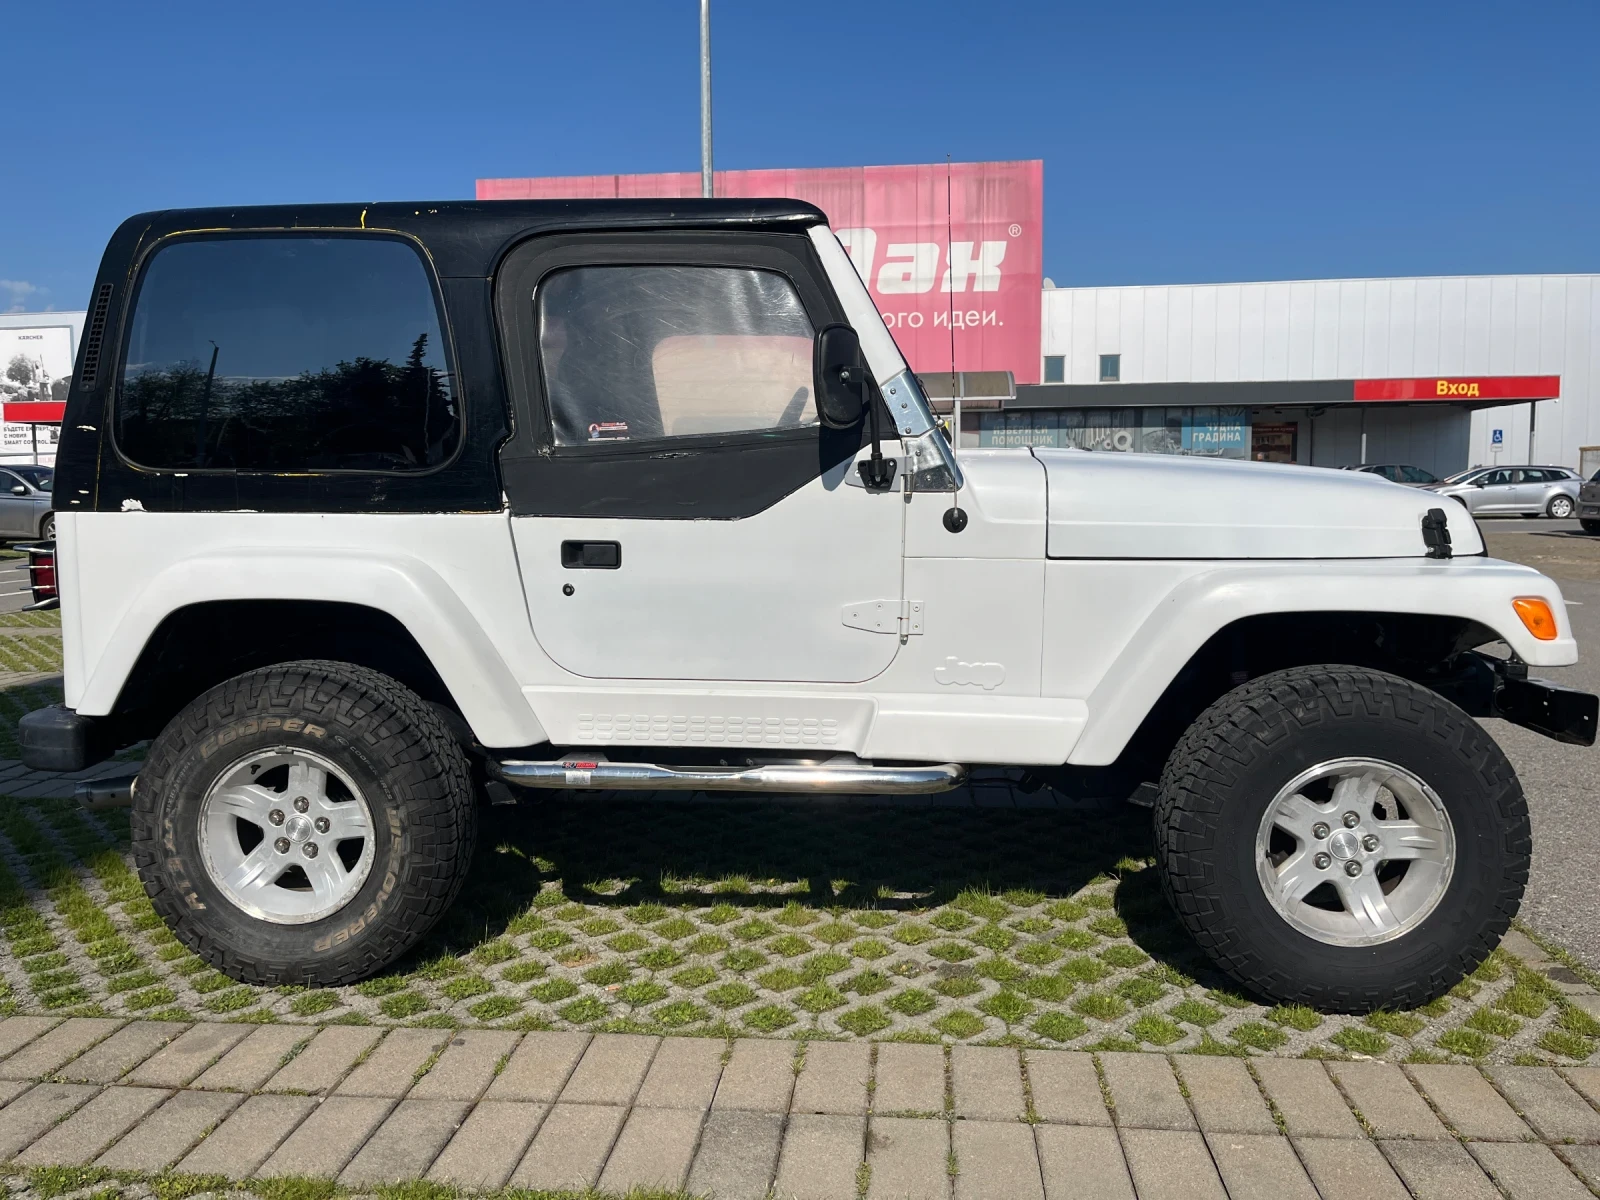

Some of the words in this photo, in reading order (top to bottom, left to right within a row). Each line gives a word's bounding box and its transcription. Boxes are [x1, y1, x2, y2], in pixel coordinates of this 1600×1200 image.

[934, 309, 1004, 330] идеи.
[1437, 380, 1479, 397] Вход
[993, 425, 1032, 435] ИЗБЕРИ
[1035, 425, 1048, 434] СИ
[1206, 422, 1241, 432] ЧУДНА
[991, 435, 1053, 445] ПОМОЩНИК
[1192, 432, 1241, 443] ГРАДИНА
[200, 718, 328, 759] COOPER
